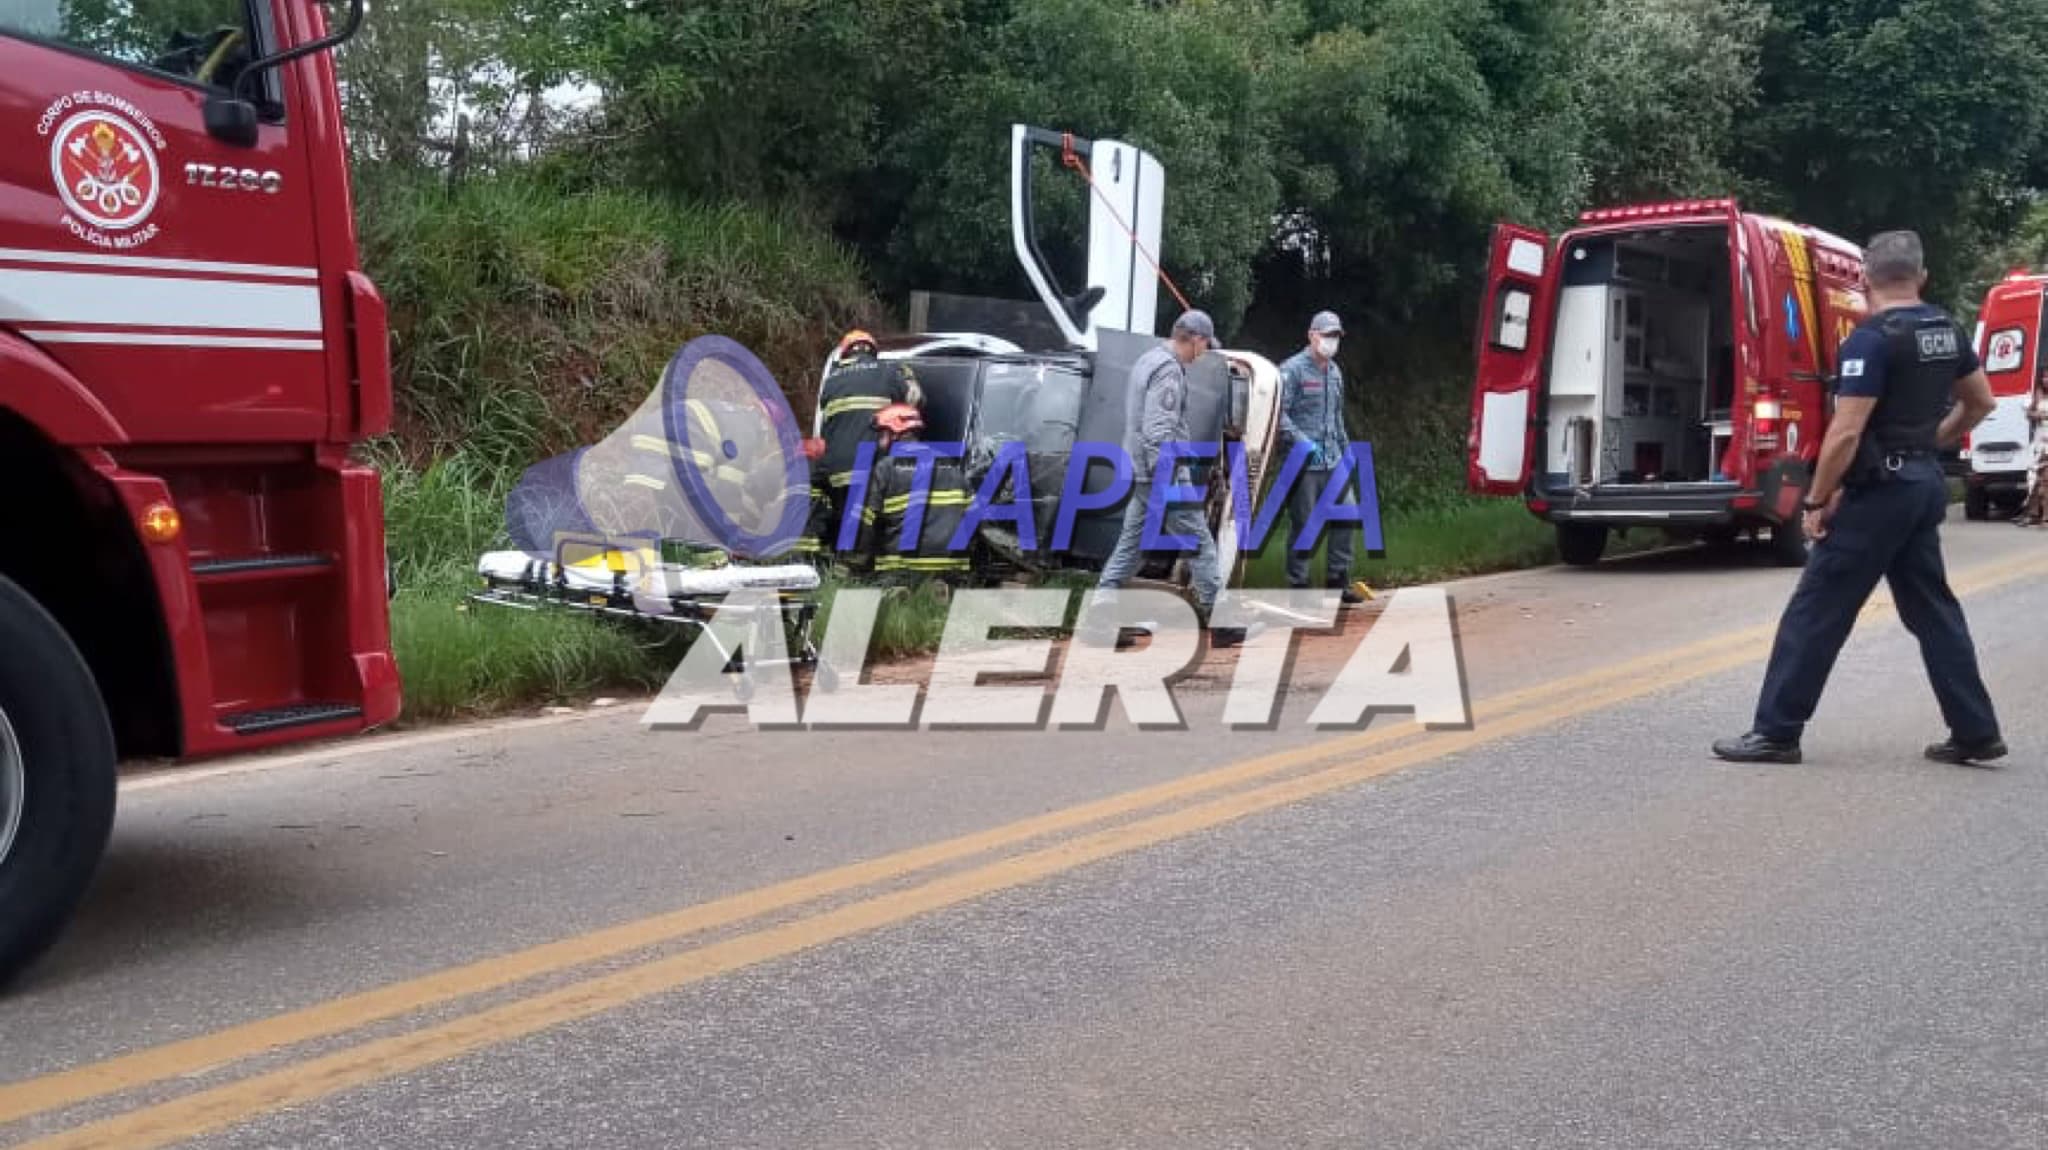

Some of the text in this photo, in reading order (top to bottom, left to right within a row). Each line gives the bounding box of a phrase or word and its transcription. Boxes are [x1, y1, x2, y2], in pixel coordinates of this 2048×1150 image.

[37, 90, 167, 149] CORPO DE BOMBEIROS
[113, 223, 160, 248] MILITAR
[1921, 333, 1957, 355] GCM
